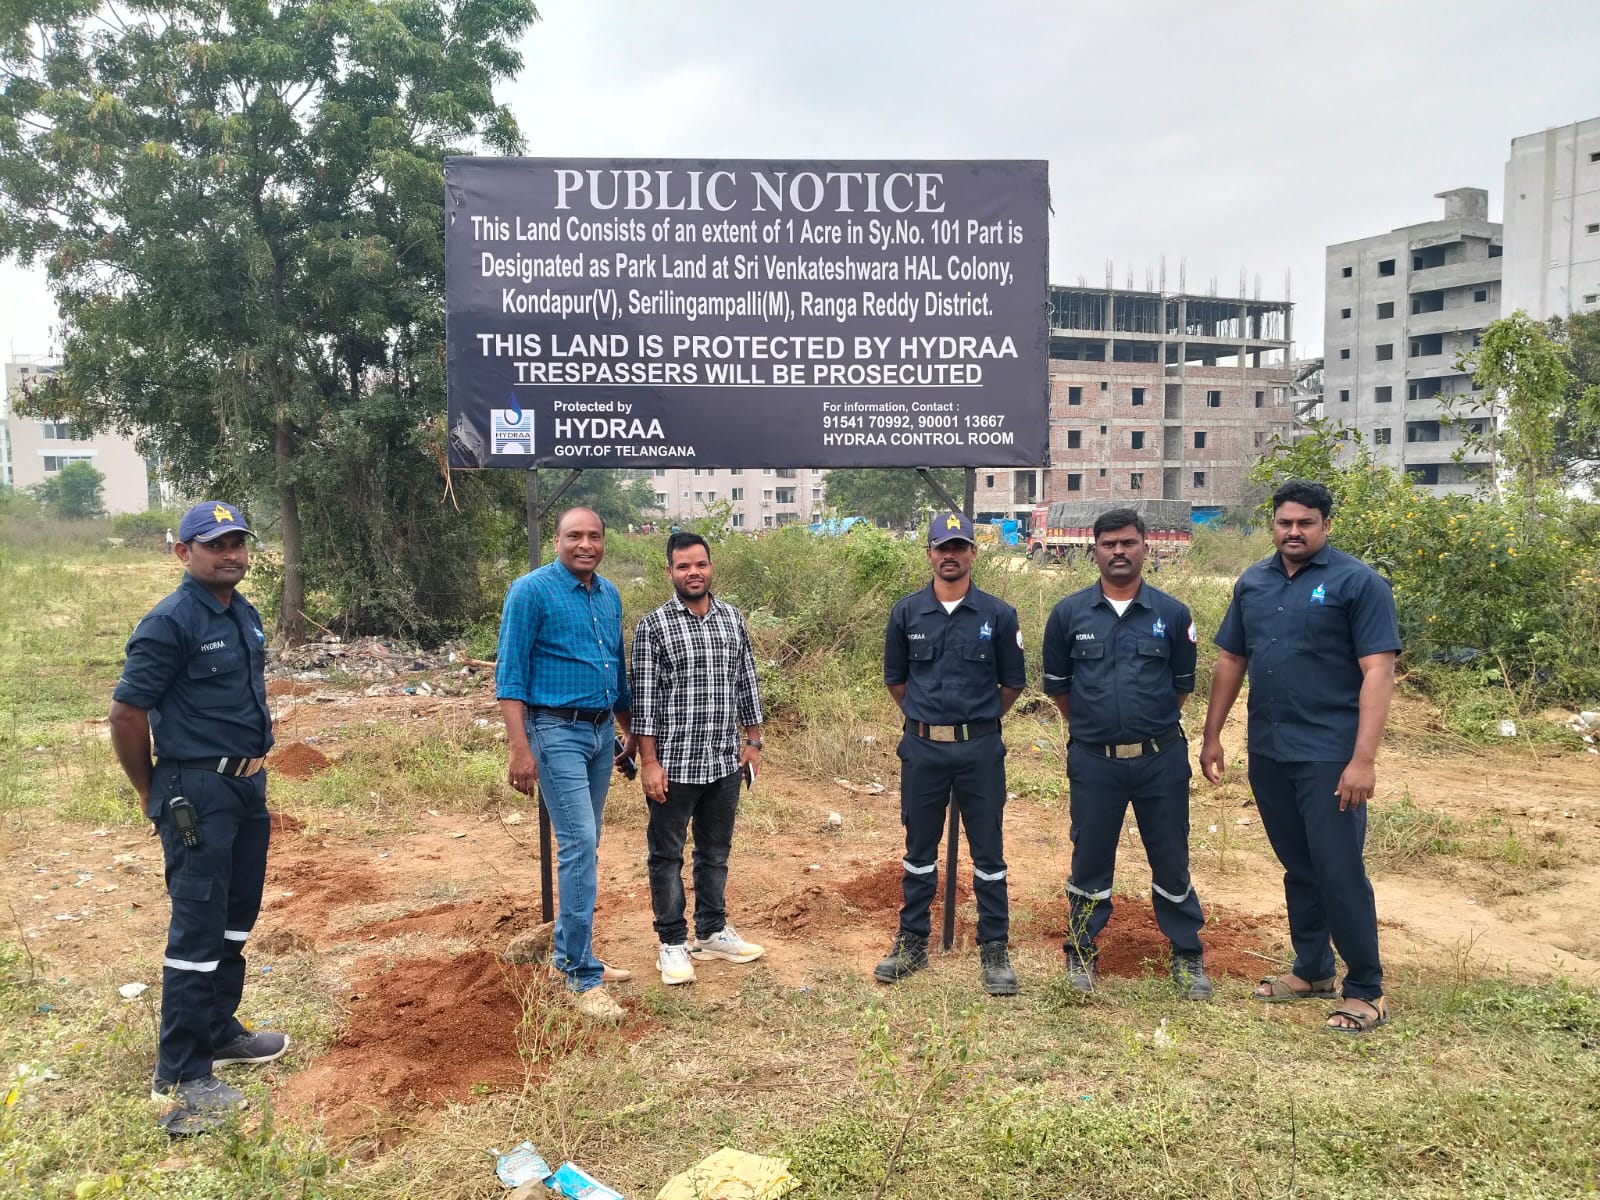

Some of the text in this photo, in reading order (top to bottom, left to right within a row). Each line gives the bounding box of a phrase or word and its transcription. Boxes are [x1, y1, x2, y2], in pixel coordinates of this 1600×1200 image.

[554, 170, 945, 212] PUBLIC NOTICE
[471, 216, 1023, 250] This Land Consists of an extent of 1 Acre in Sy.No. 101 Part is
[482, 252, 1013, 286] Designated as Park Land at Sri Venkateshwara HAL Colony,
[503, 288, 992, 322] Kondapur(V), Serilingampalli(M), Ranga Reddy District.
[477, 334, 1018, 359] THIS LAND IS PROTECTED BY HYDRAA
[514, 362, 982, 384] TRESPASSERS WILL BE PROSECUTED
[554, 401, 632, 414] Protected by
[824, 402, 841, 411] For
[845, 402, 908, 412] information,
[912, 402, 953, 411] Contact
[556, 418, 664, 438] HYDRAA
[824, 415, 1005, 430] 91541 70992, 90001 13667
[969, 432, 1013, 444] ROOM
[555, 446, 695, 456] GOVT.OF TELANGANA
